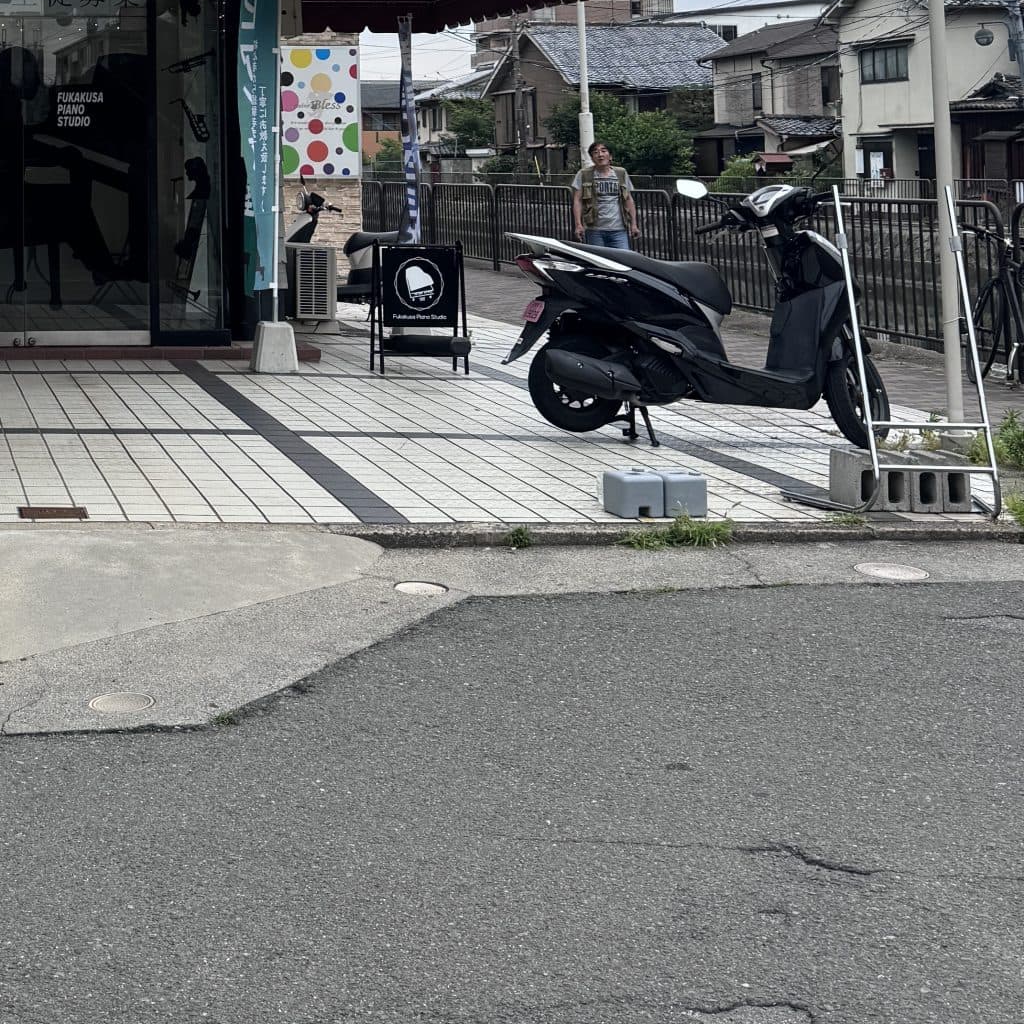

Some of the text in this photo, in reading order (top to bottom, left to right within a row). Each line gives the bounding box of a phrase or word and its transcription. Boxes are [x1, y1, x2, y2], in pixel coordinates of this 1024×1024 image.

[57, 91, 104, 103] FUKAKUSA
[57, 103, 85, 115] PIANO
[310, 98, 341, 110] Bless
[57, 115, 91, 127] STUDIO
